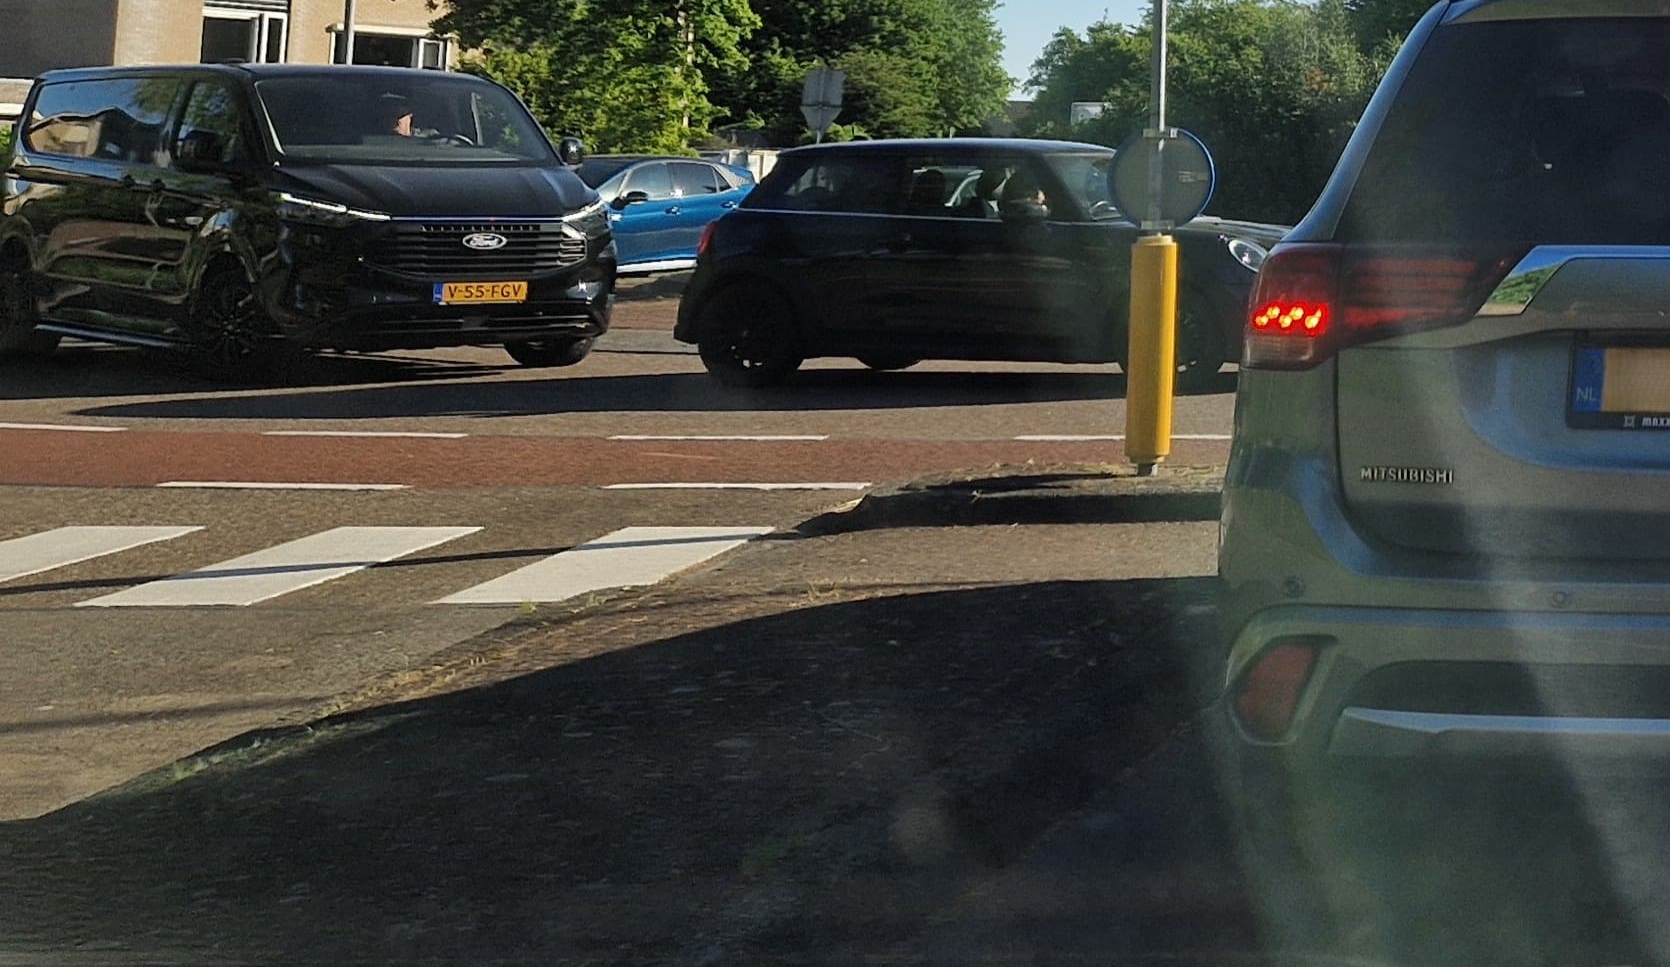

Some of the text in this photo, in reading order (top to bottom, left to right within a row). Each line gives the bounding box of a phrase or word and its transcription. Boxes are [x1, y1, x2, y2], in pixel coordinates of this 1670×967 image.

[448, 283, 522, 299] V-55-FGV
[1575, 386, 1597, 402] NL
[1360, 466, 1454, 483] MITSUBISHI
